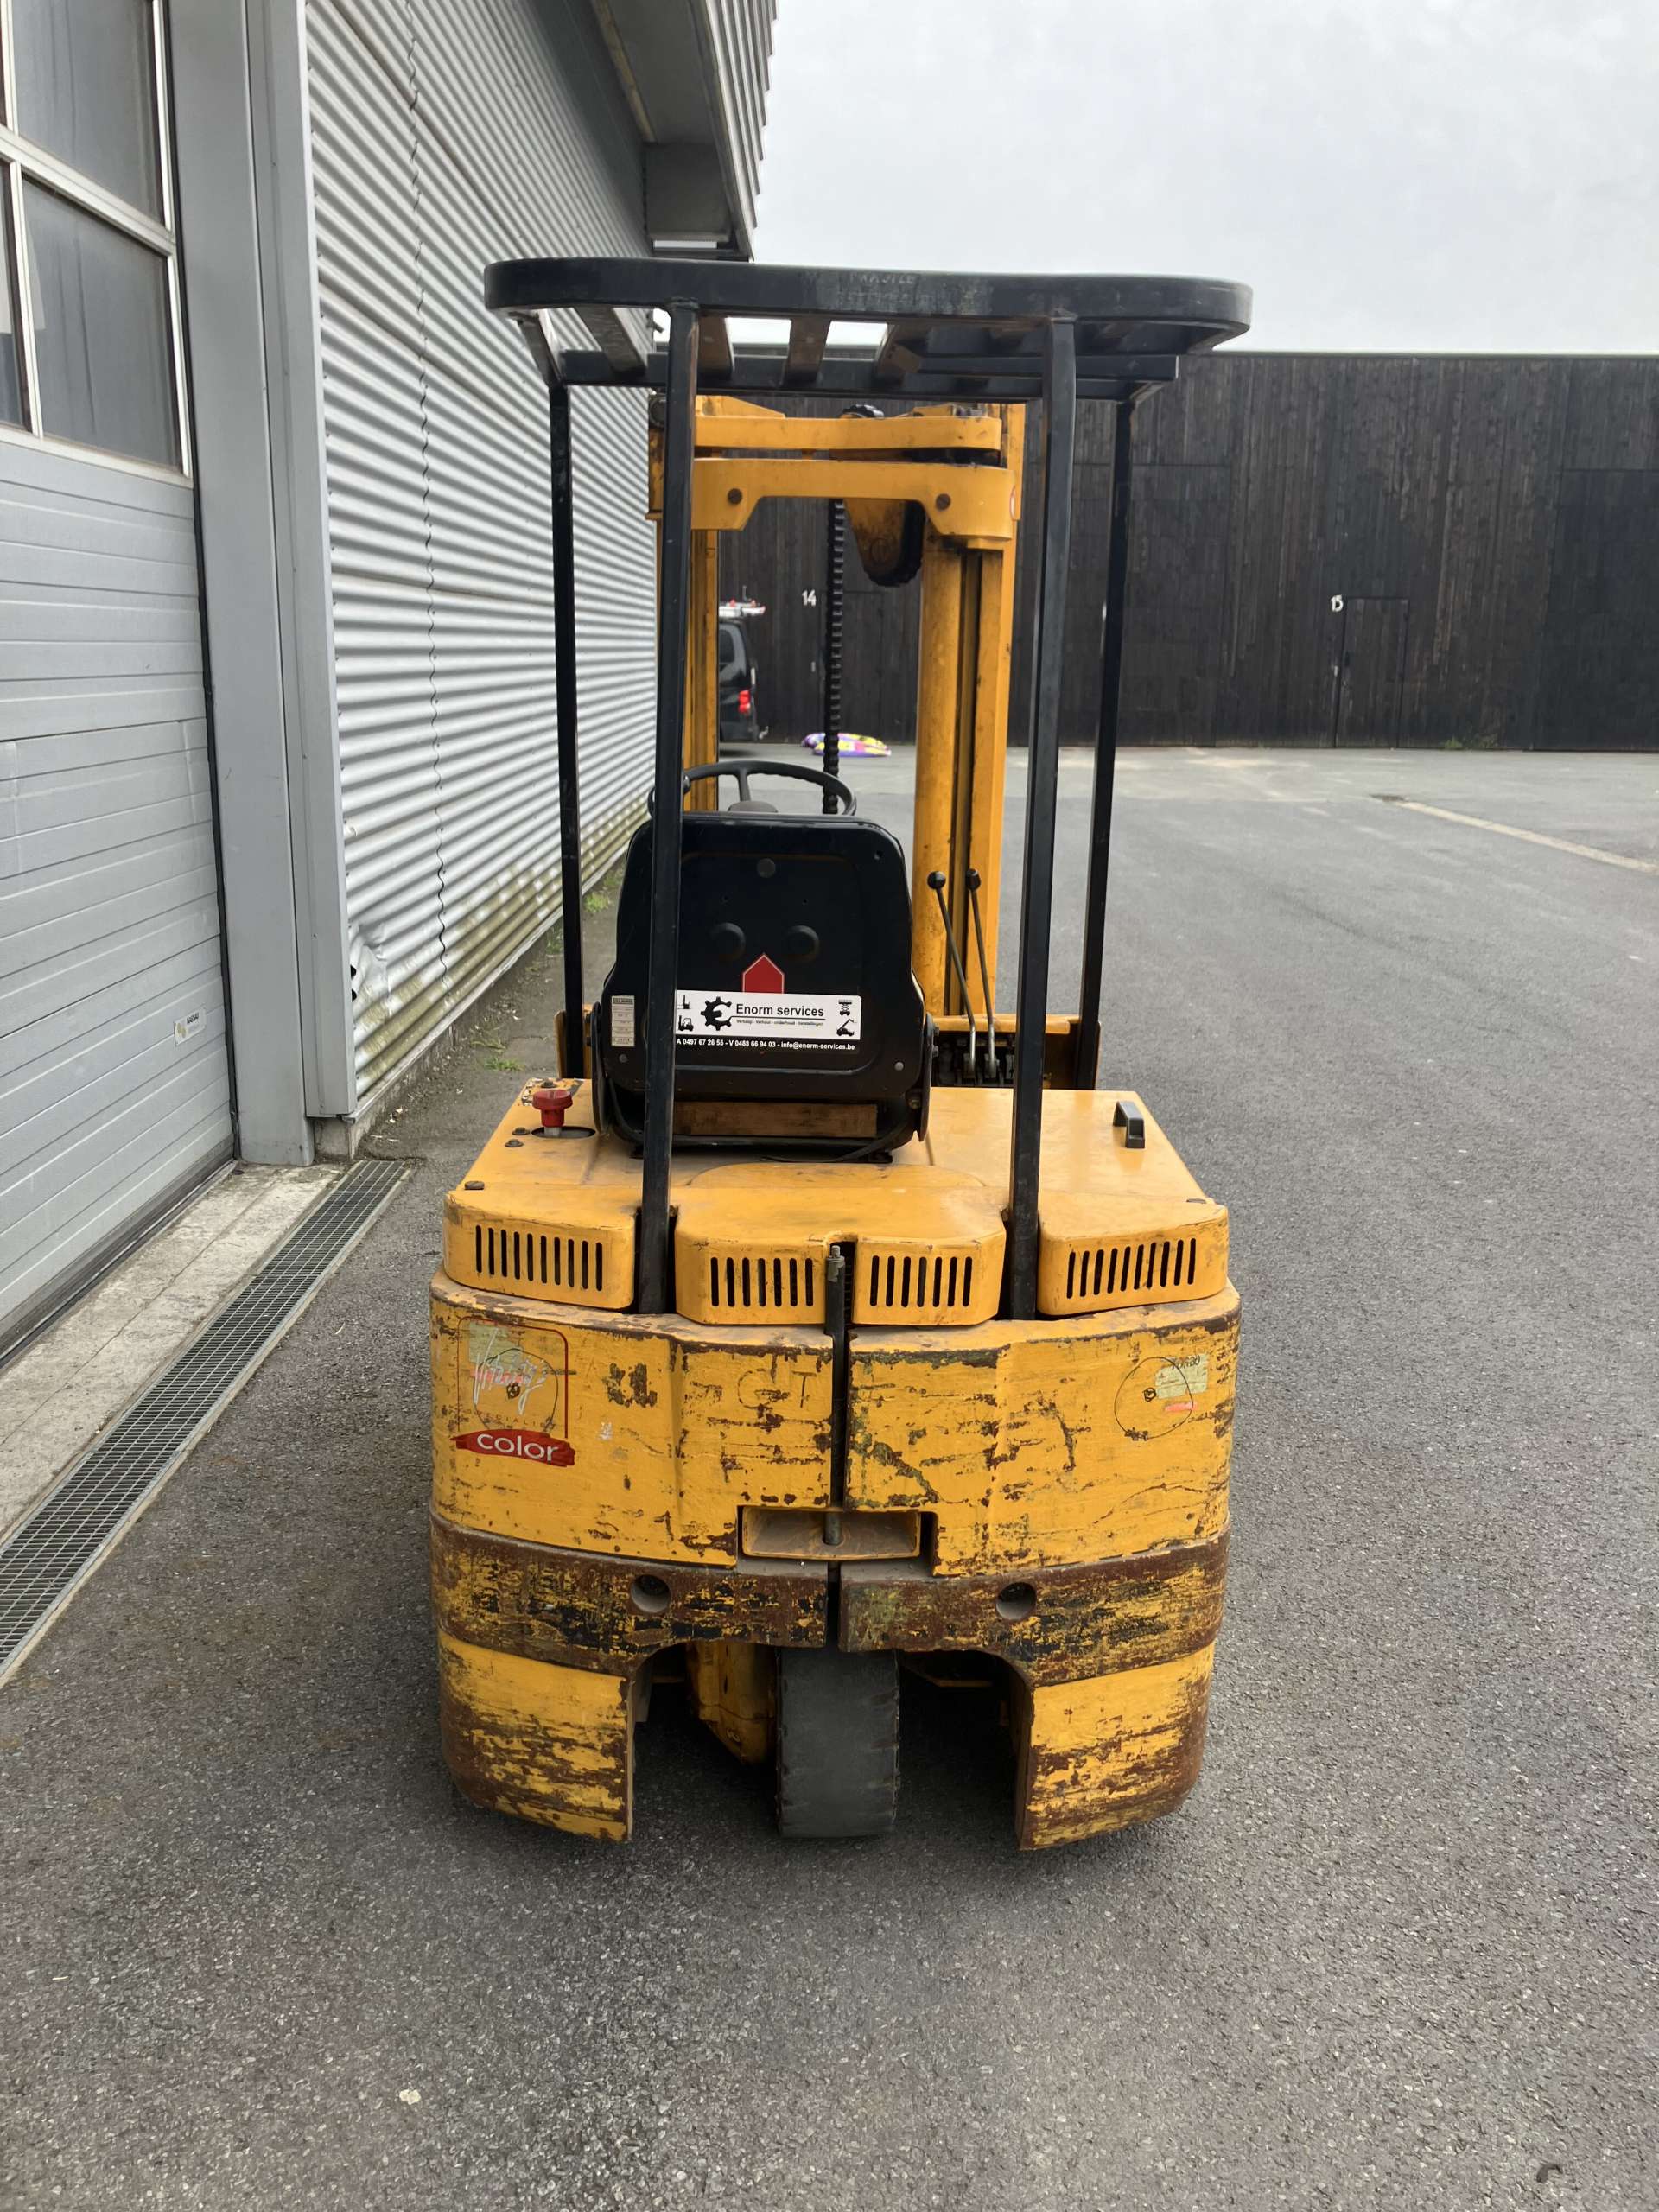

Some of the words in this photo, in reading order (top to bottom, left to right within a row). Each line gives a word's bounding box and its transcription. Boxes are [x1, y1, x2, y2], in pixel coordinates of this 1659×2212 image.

[802, 589, 817, 607] 14
[1330, 594, 1344, 612] 15
[736, 1003, 773, 1015] Enorm
[777, 1005, 824, 1016] services
[781, 1041, 855, 1050] info@enorm-services.be
[476, 1433, 559, 1462] color
